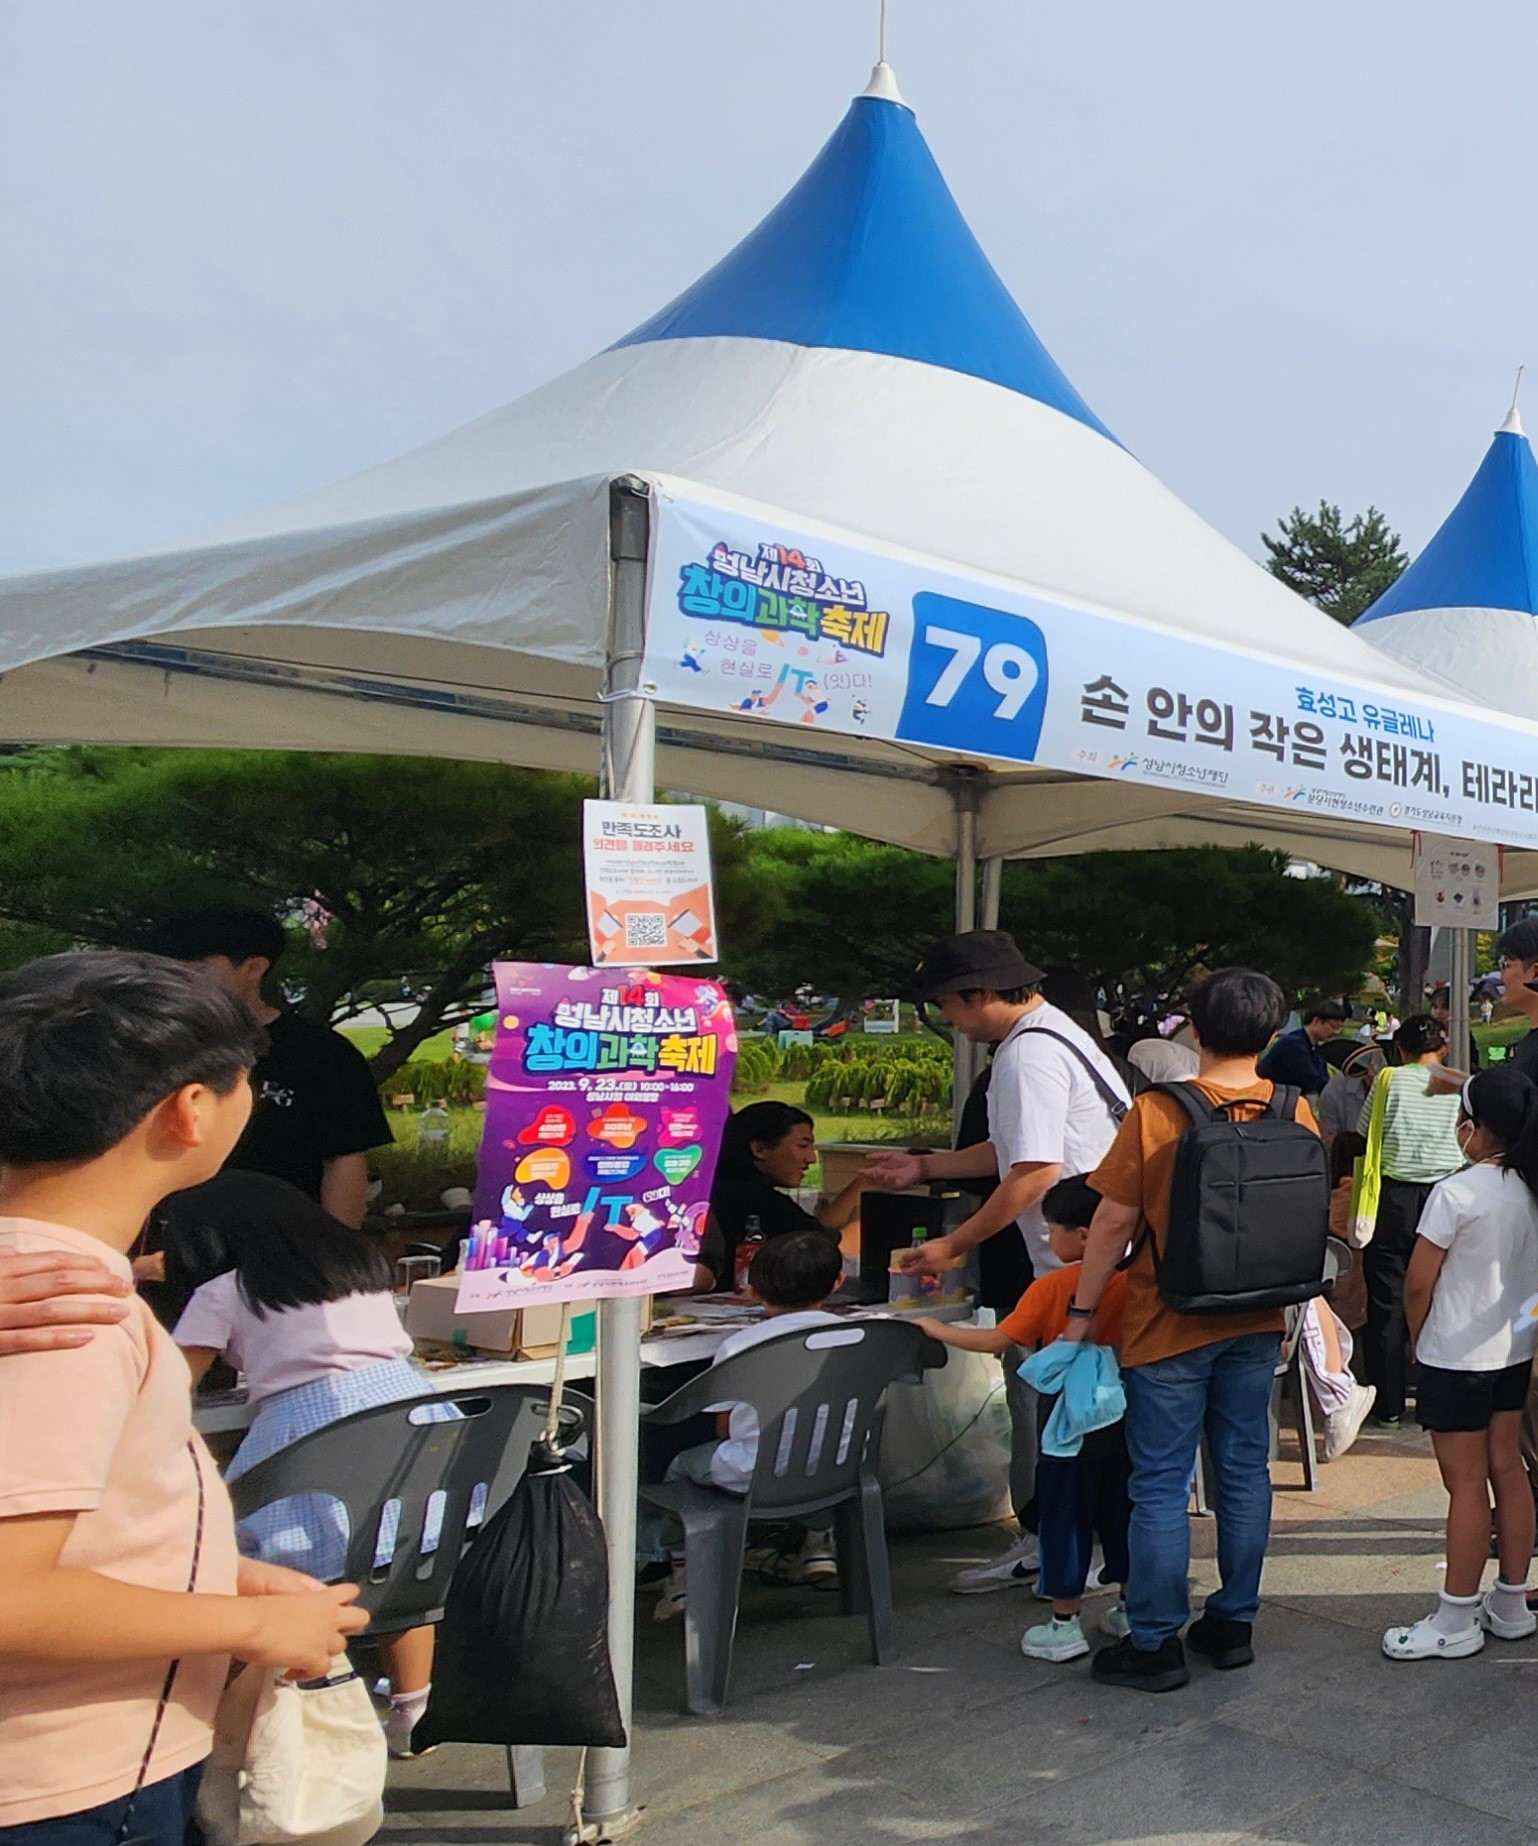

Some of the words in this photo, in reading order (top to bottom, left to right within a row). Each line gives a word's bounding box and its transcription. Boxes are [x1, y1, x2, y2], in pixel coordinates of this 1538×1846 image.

[759, 543, 822, 574] 제14회
[704, 629, 758, 657] 상상을
[721, 657, 773, 680] 현실로
[925, 625, 1038, 720] 79
[1295, 686, 1357, 723] 효성고
[1362, 703, 1435, 744] 유글레나
[1080, 673, 1130, 731] 손
[1146, 686, 1235, 752] 안의
[1248, 709, 1327, 771] 작은
[1338, 731, 1451, 799] 생태계,
[602, 820, 682, 839] 만족도조사
[593, 838, 628, 851] 의견을
[601, 985, 660, 1007] 제14회
